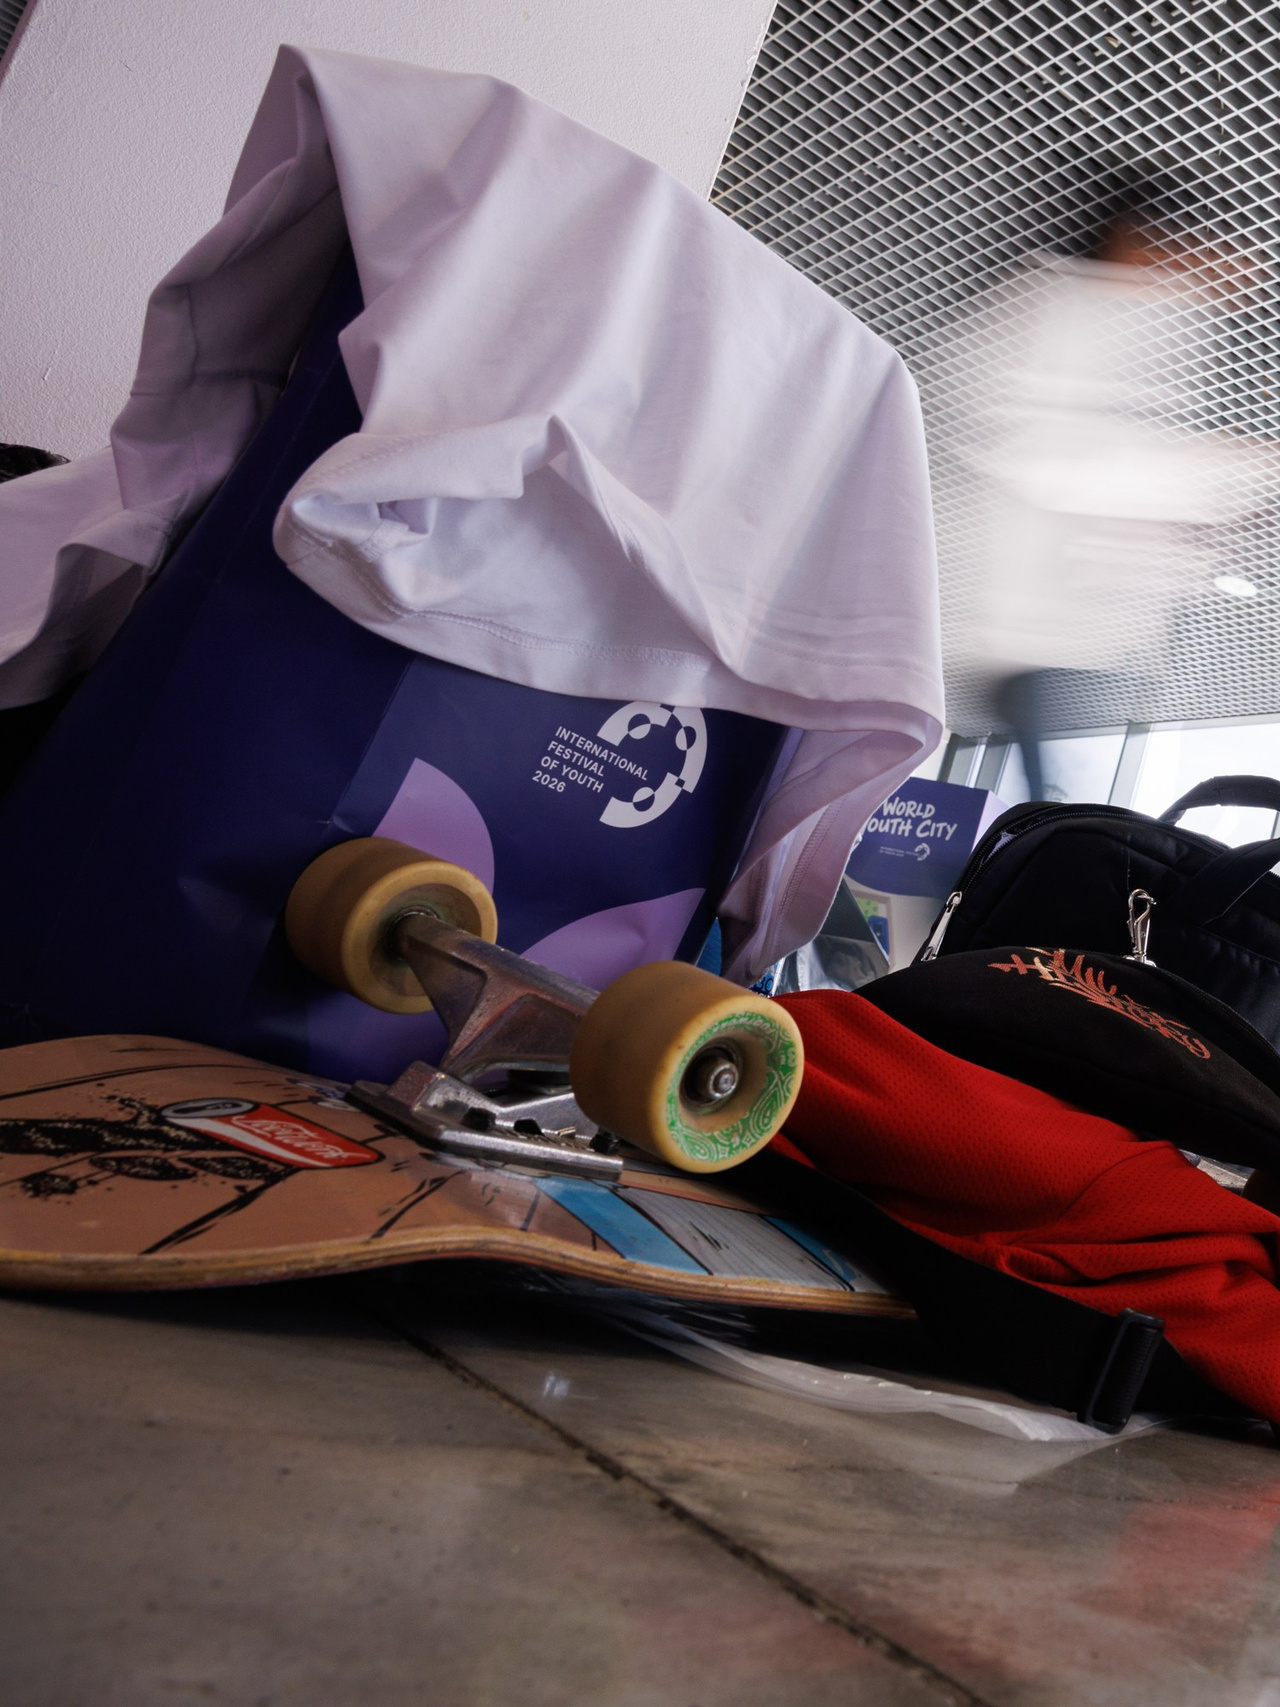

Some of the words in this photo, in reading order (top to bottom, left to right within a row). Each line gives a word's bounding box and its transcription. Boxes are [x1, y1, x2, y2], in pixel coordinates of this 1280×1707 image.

[547, 740, 605, 777] FESTIVAL
[555, 726, 648, 781] INTERNATIONAL
[532, 770, 567, 793] 2026
[540, 755, 560, 771] OF
[562, 764, 605, 793] YOUTH
[882, 796, 936, 819] WORLD
[867, 817, 913, 837] OUTH
[915, 819, 958, 841] CITY
